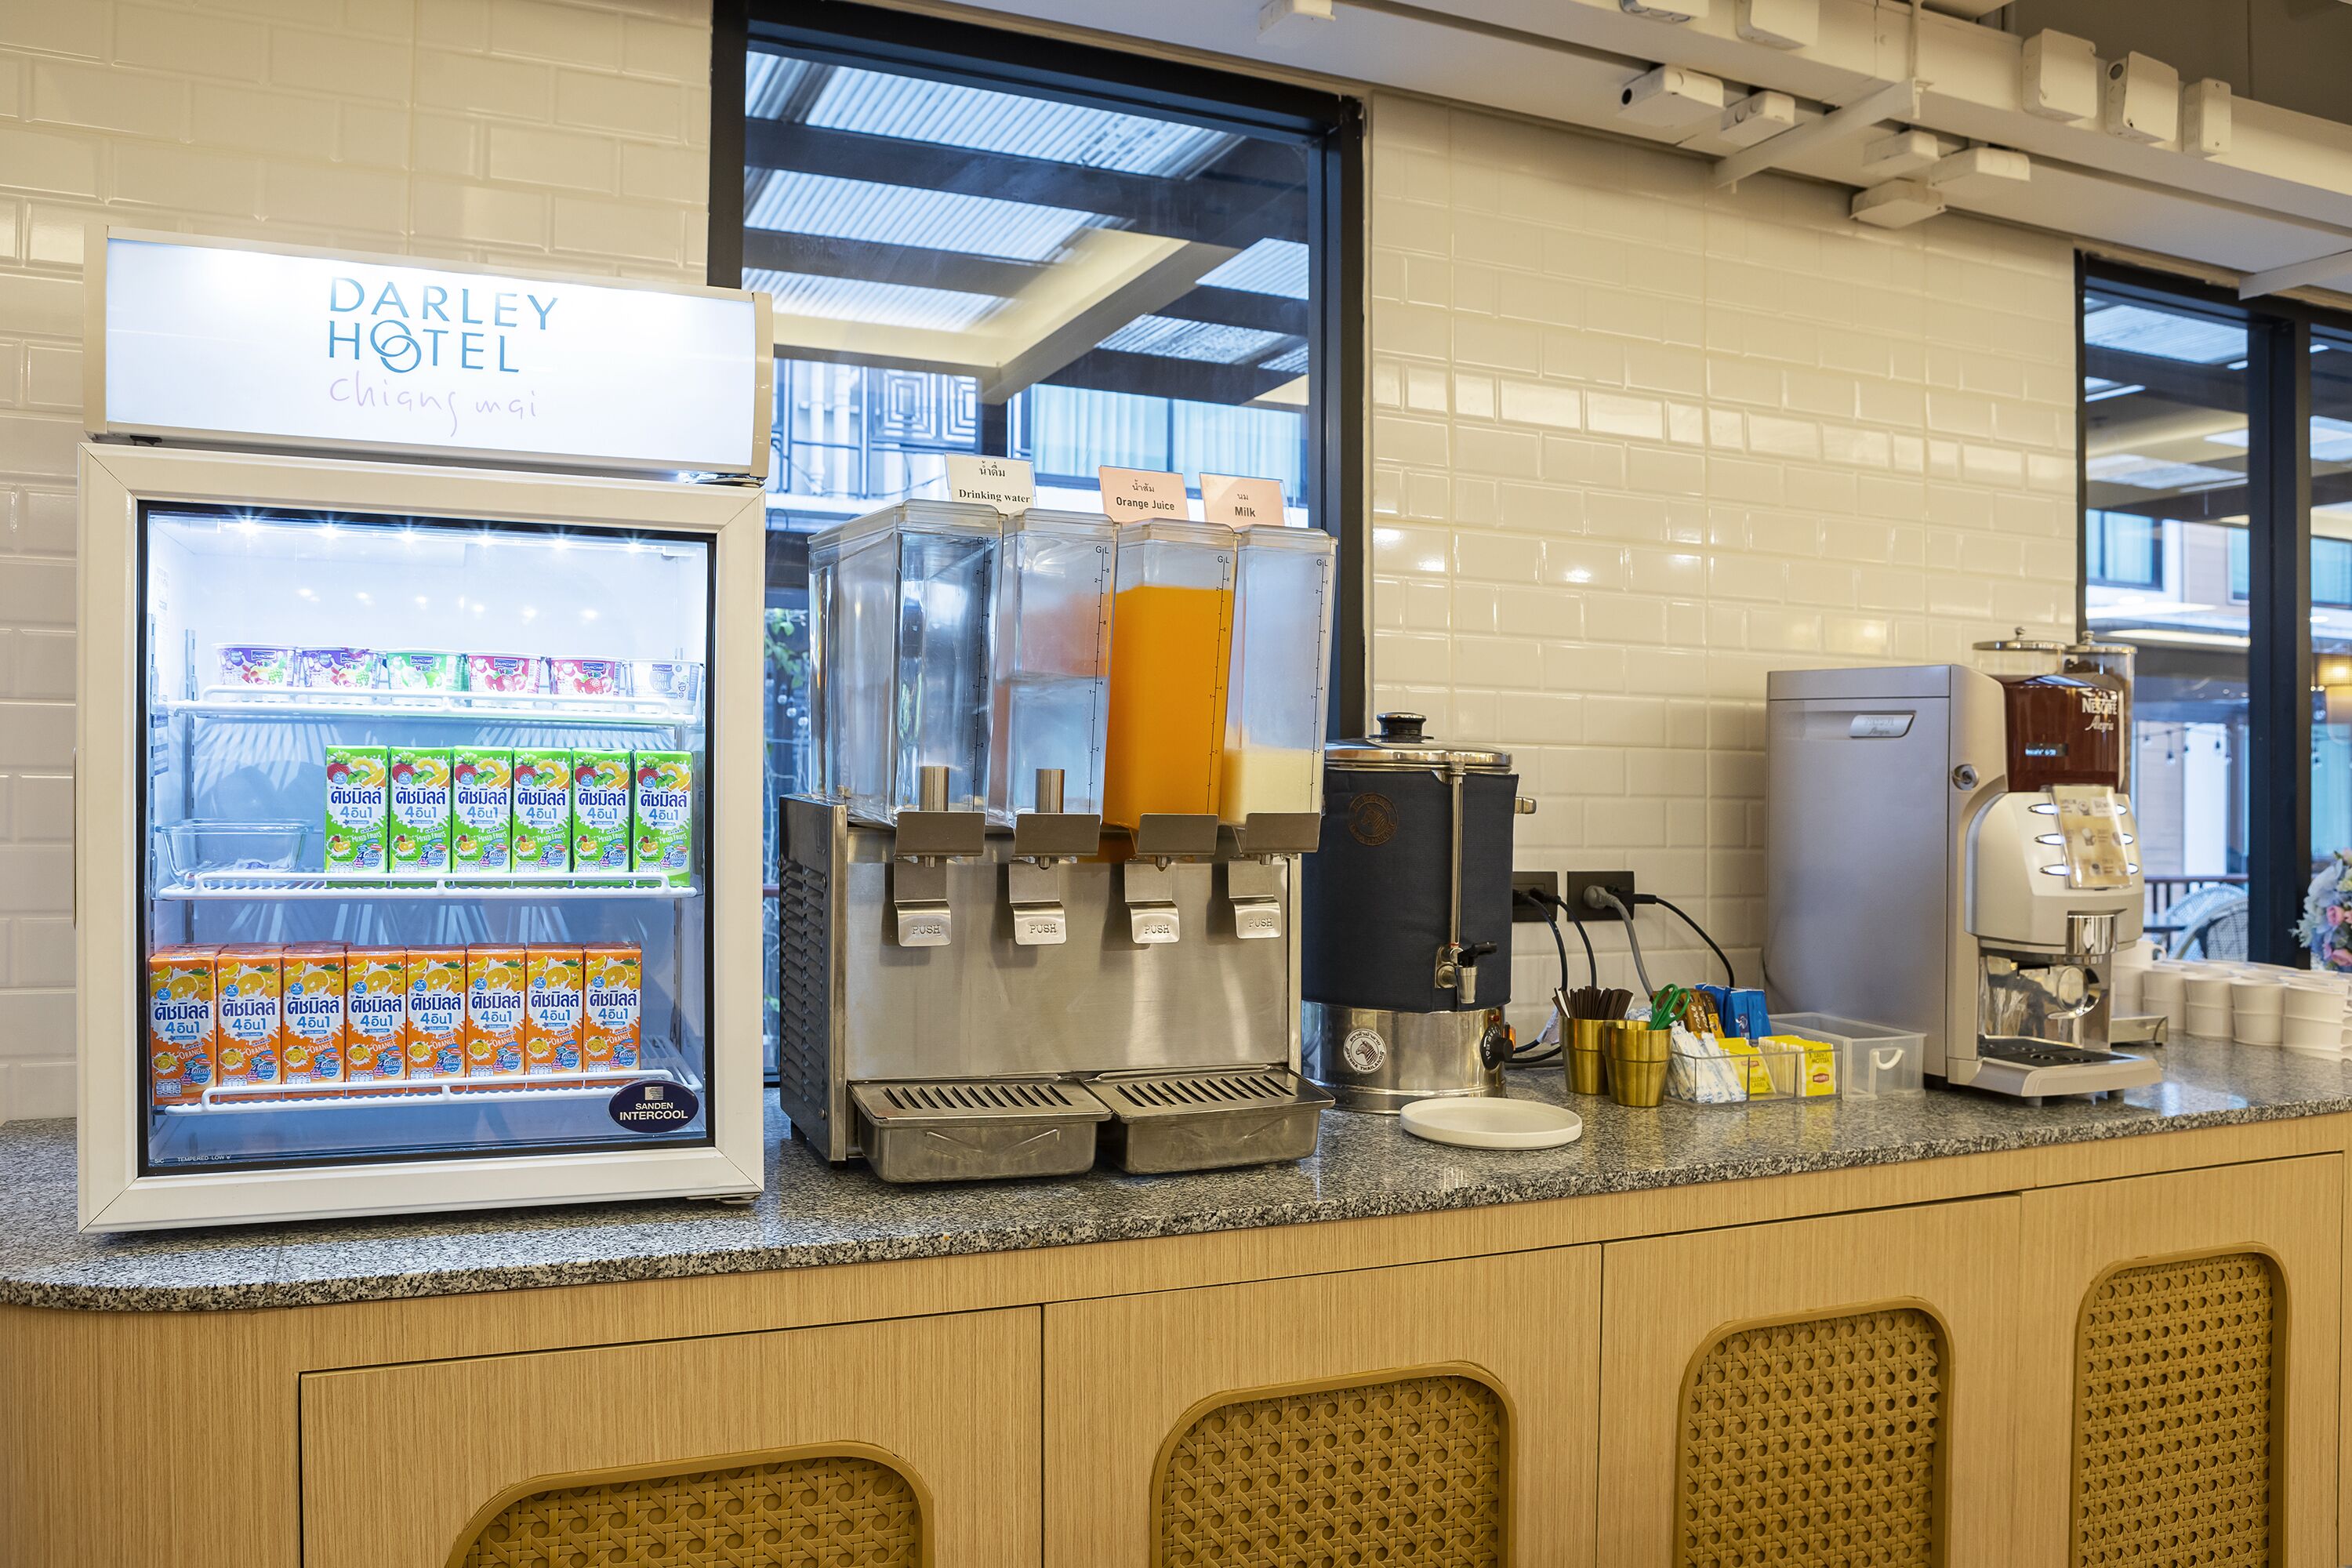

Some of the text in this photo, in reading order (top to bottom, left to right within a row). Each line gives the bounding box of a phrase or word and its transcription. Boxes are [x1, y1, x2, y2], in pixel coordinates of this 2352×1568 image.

[330, 277, 558, 330] DARLEY
[329, 319, 519, 373] HOTEL
[978, 460, 1006, 477] น้ำดื่ม
[1132, 479, 1155, 492] น้ำส้ม
[959, 488, 1030, 503] Drinking water
[1116, 496, 1175, 510] Orange Juice
[1236, 492, 1249, 501] นม
[1235, 506, 1256, 517] Milk
[330, 786, 382, 805] ดัชมิลล์
[395, 787, 445, 805] ดัชมิลล์
[458, 787, 507, 805] ดัชมิลล์
[517, 789, 566, 806] ดัชมิลล์
[578, 789, 626, 806] ดัชมิลล์
[640, 789, 688, 808] ดัชมิลล์
[912, 924, 941, 935] PUSH
[1029, 924, 1057, 934] PUSH
[1144, 924, 1170, 934] PUSH
[1248, 917, 1273, 927] PUSH
[287, 996, 339, 1014] ดัชมิลล์
[350, 995, 402, 1013] ดัชมิลล์
[411, 993, 461, 1011] ดัชมิลล์
[471, 991, 521, 1009] ดัชมิลล์
[531, 989, 579, 1007] ดัชมิลล์
[590, 989, 637, 1007] ดัชมิลล์
[154, 1000, 209, 1020] ดัชมิลล์
[222, 998, 275, 1017] ดัชมิลล์
[432, 1036, 456, 1050] ORANGE
[492, 1035, 516, 1048] ORANGE
[550, 1033, 575, 1046] ORANGE
[608, 1032, 632, 1044] ORANGE
[179, 1046, 205, 1060] ORANGE
[245, 1044, 270, 1057] ORANGE
[309, 1040, 335, 1054] ORANGE
[372, 1040, 397, 1053] ORANGE
[1360, 1055, 1383, 1071] THAILAND
[619, 1110, 688, 1120] INTERCOOL
